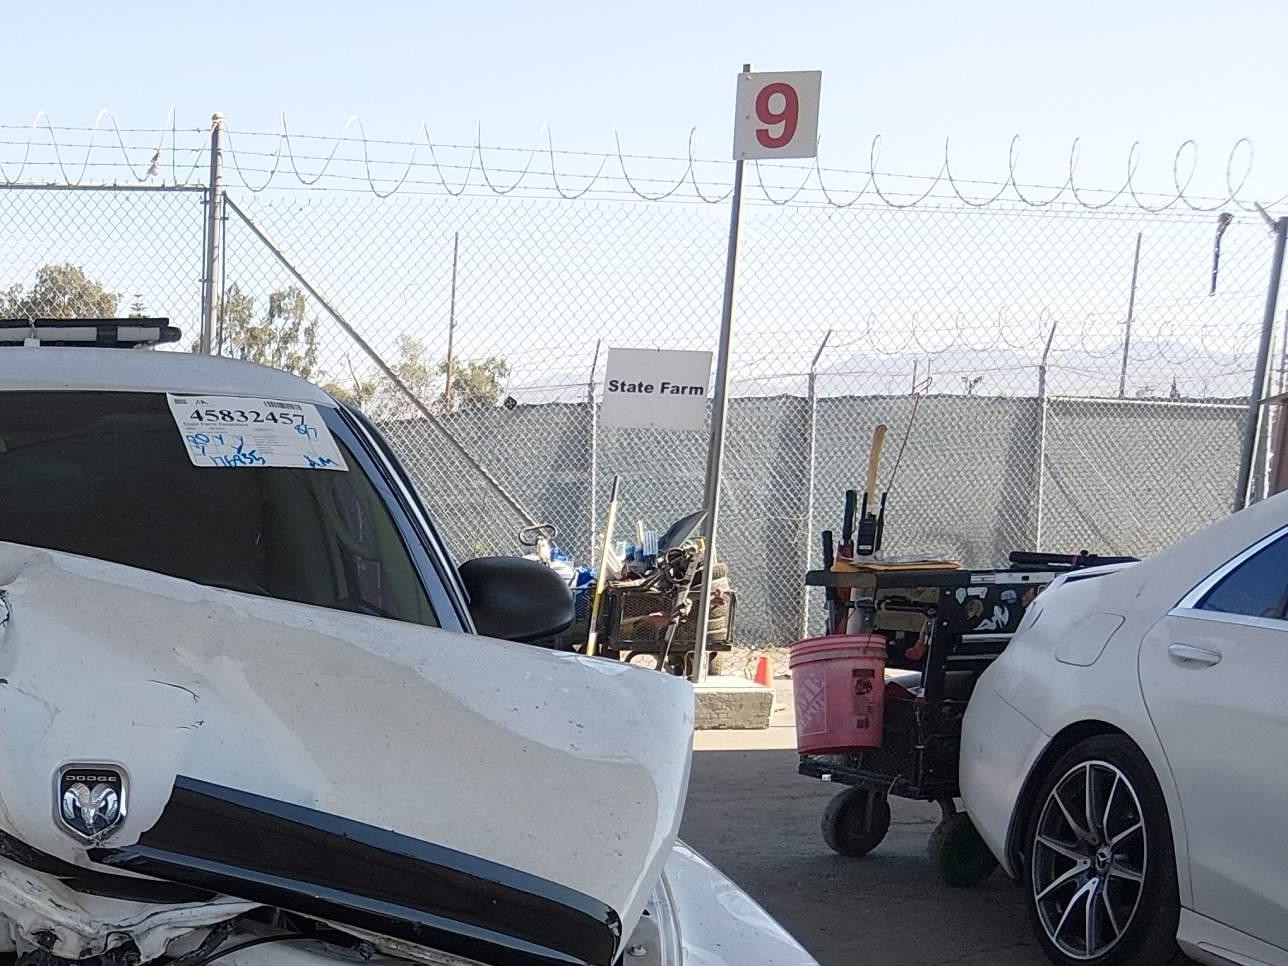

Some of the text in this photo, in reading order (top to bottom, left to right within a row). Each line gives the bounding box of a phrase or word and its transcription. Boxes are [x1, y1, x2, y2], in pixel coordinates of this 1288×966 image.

[755, 82, 799, 149] 9
[608, 379, 704, 396] State Farm
[189, 409, 305, 426] 45832457
